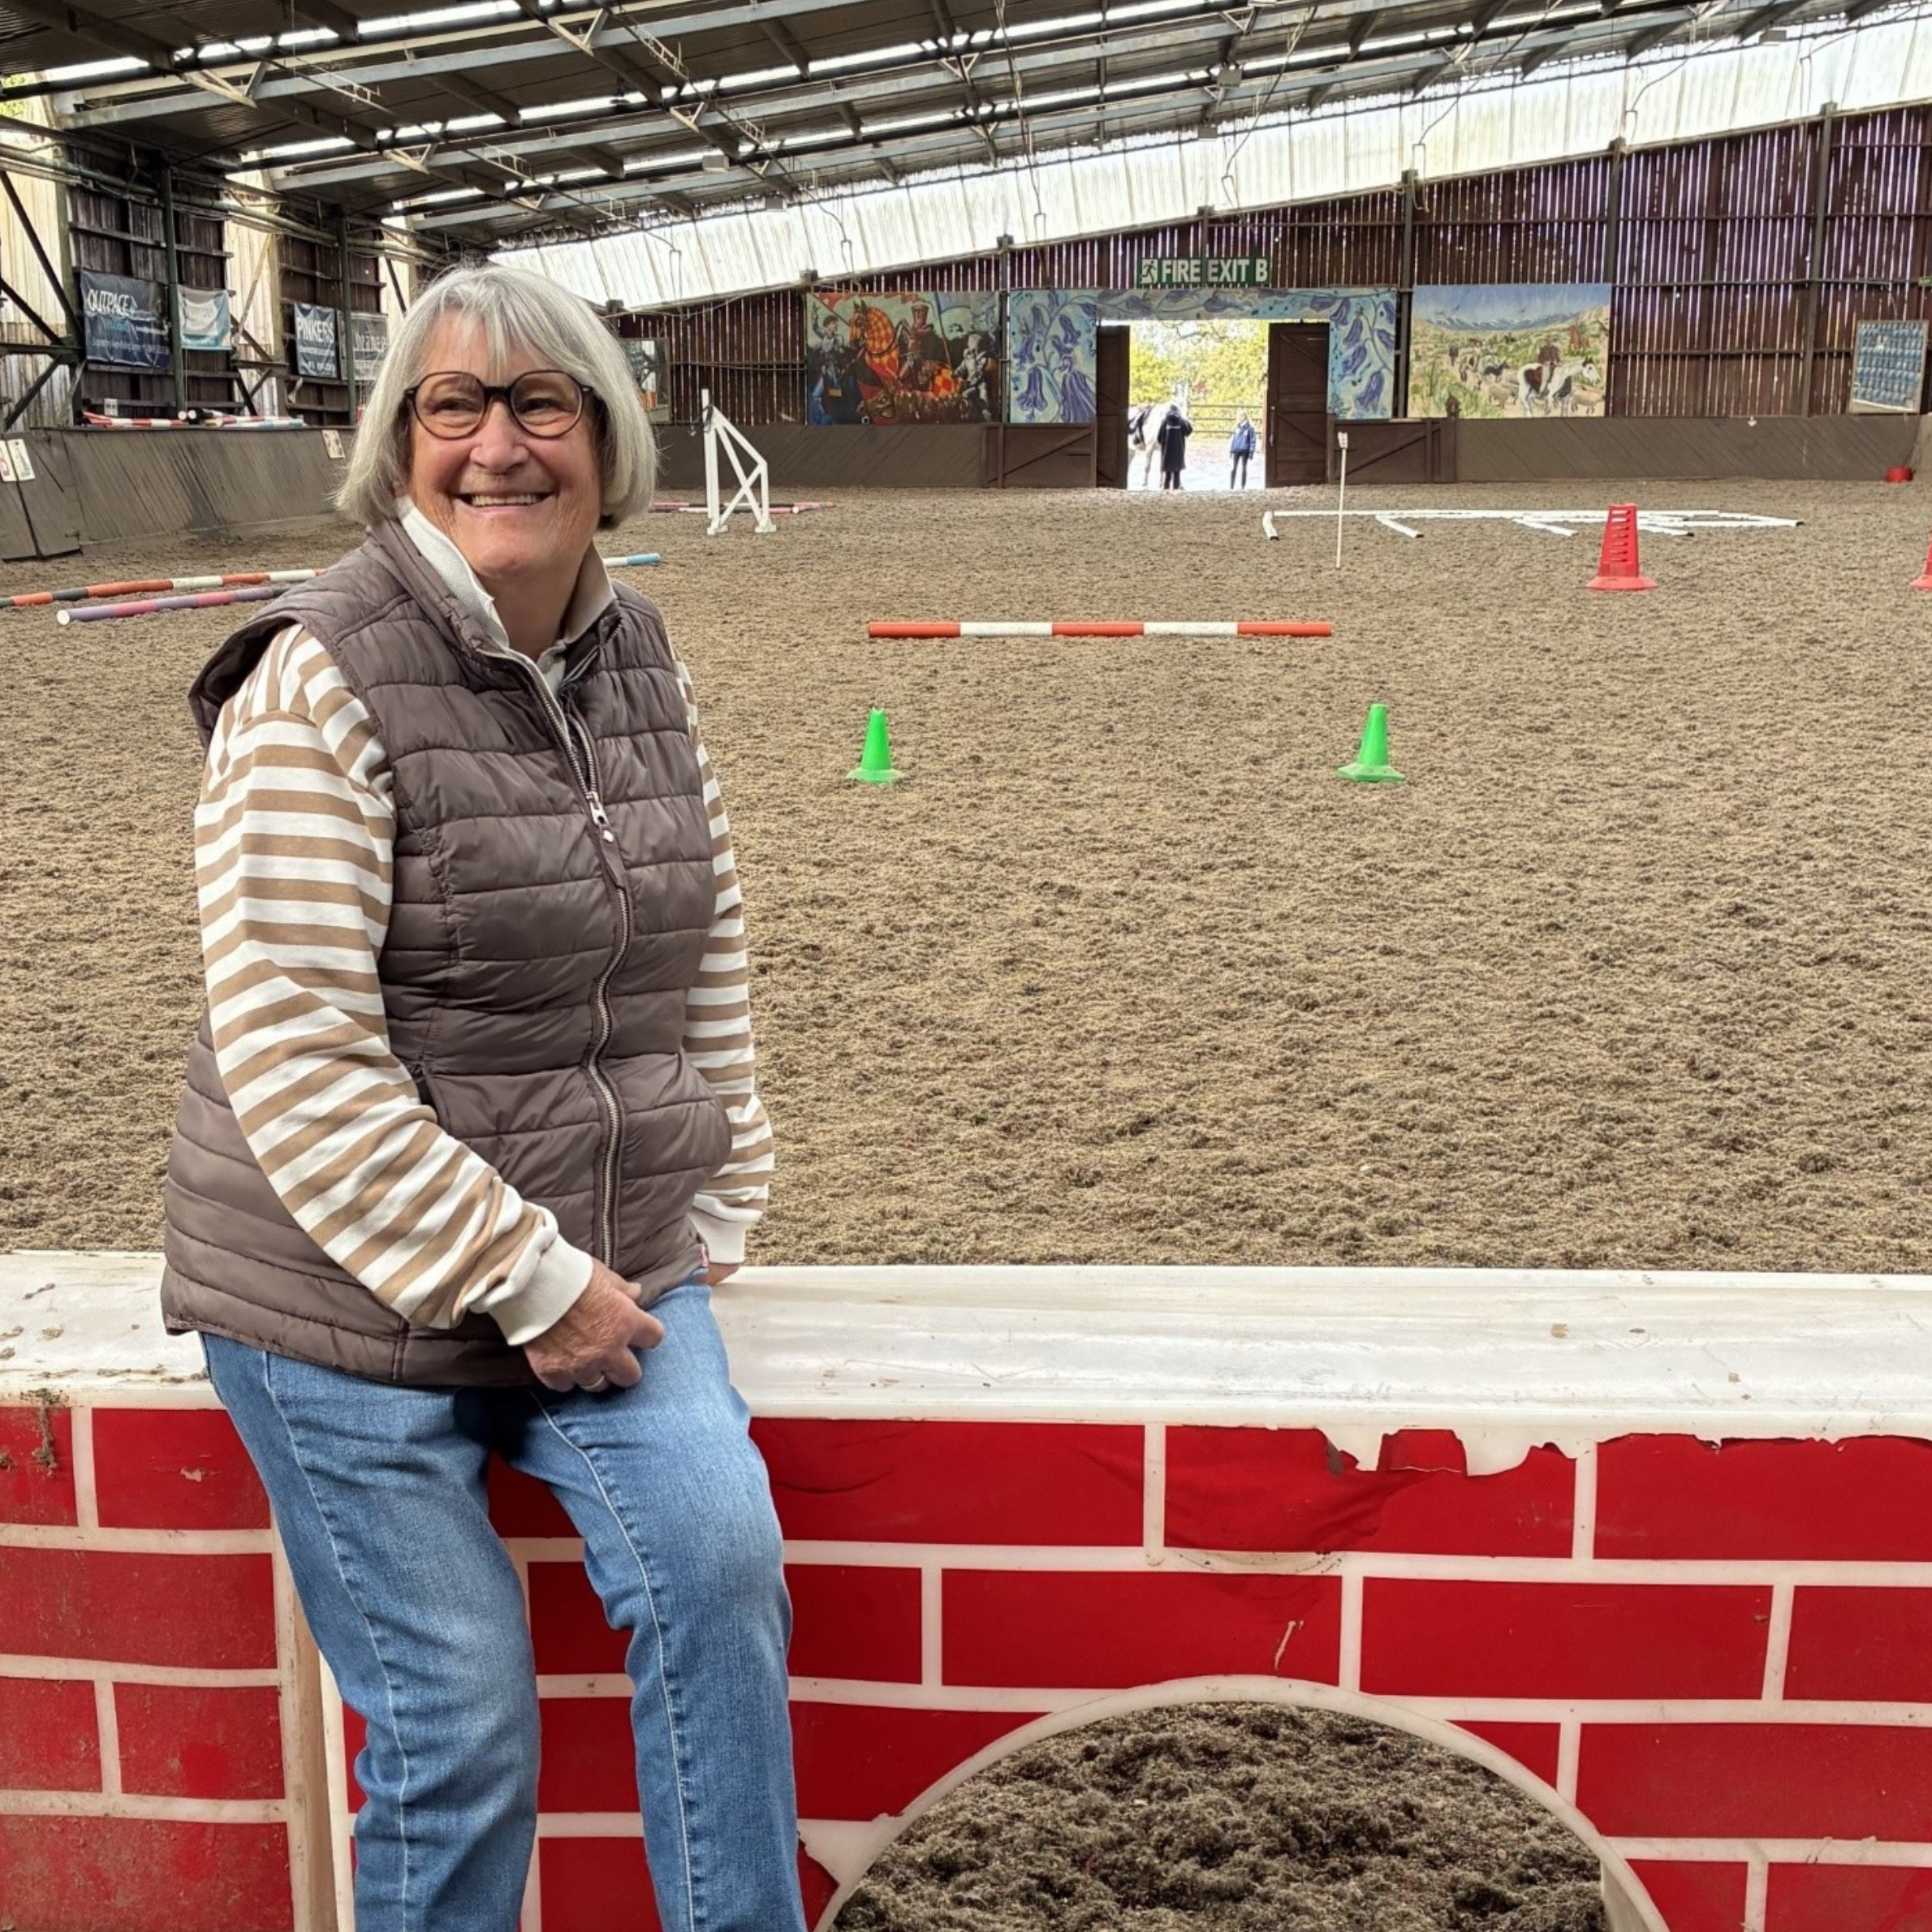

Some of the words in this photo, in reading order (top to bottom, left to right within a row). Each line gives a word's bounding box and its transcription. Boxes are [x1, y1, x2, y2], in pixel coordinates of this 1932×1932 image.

[1162, 259, 1201, 282] FIRE
[1207, 259, 1250, 282] EXIT
[1255, 259, 1268, 282] B
[88, 289, 130, 318] OUTPACE
